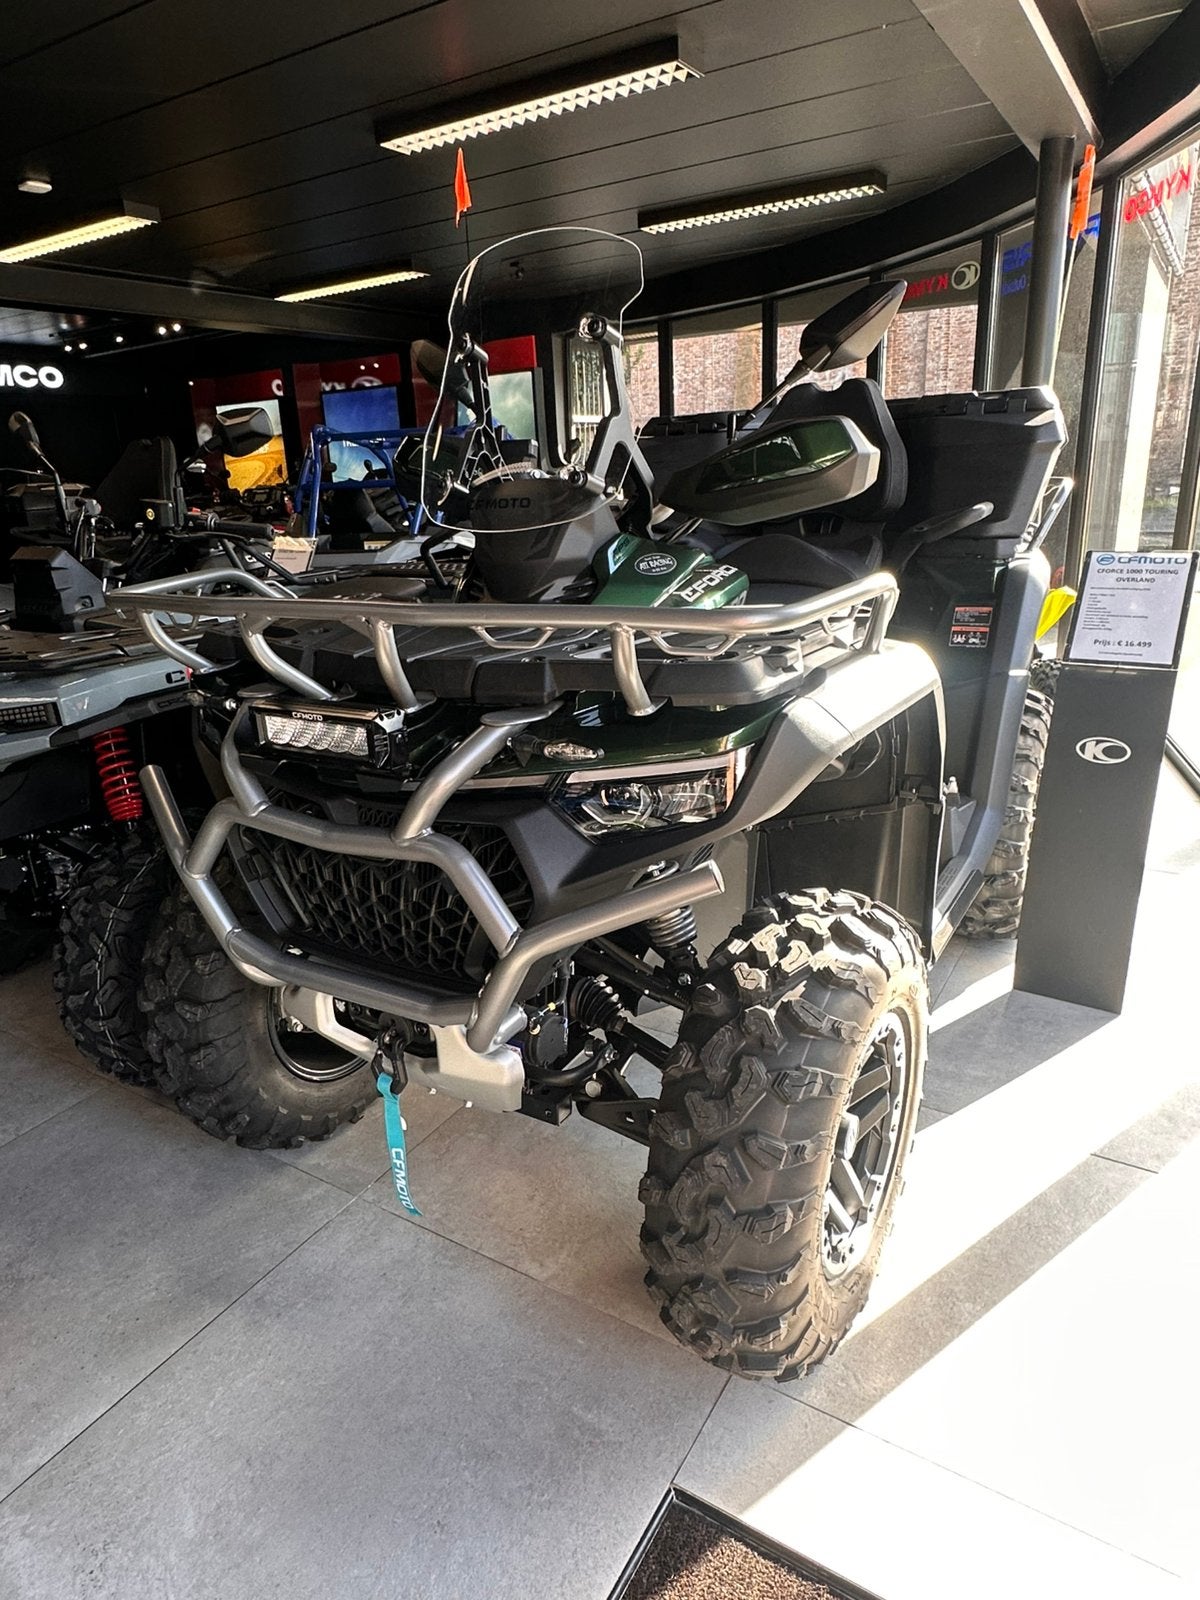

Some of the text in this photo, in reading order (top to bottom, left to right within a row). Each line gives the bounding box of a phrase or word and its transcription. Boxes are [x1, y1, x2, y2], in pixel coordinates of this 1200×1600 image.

[1117, 555, 1188, 565] CFMOTO
[680, 564, 738, 603] CFORC
[1093, 639, 1111, 647] Prijs
[1125, 640, 1152, 648] 16.499
[292, 711, 324, 721] CFMOTO
[391, 1147, 415, 1210] CFMOTO
